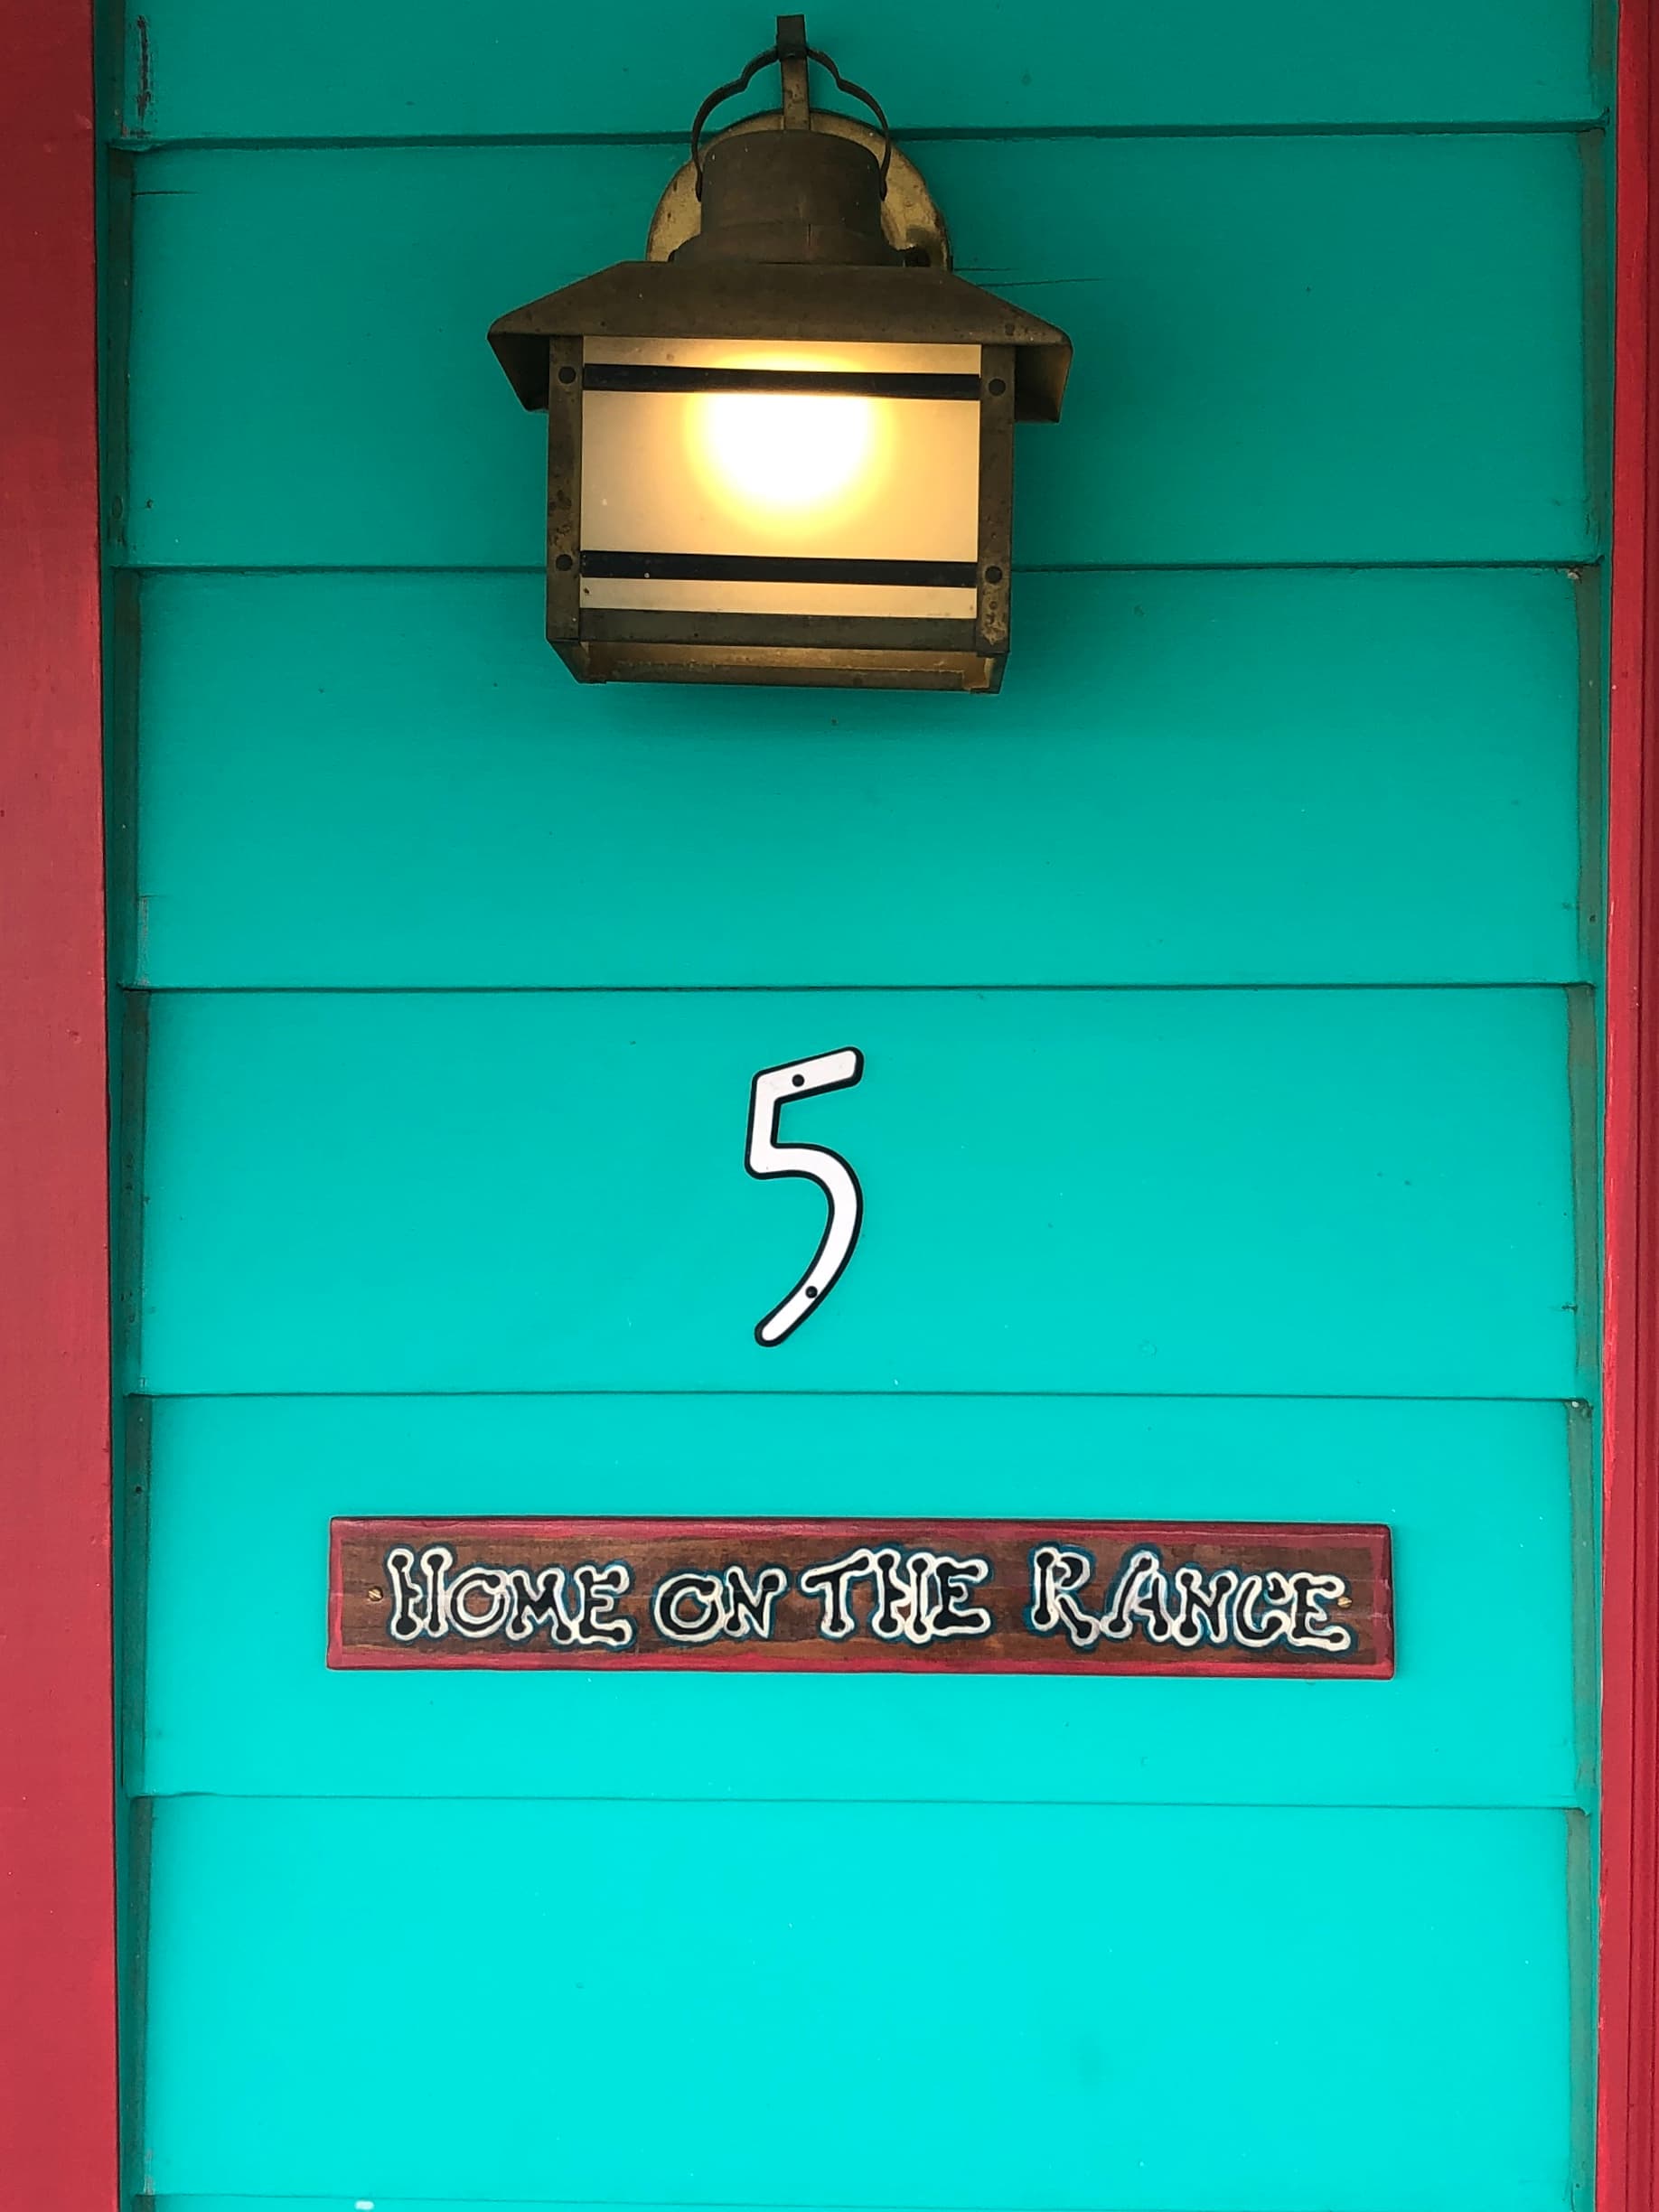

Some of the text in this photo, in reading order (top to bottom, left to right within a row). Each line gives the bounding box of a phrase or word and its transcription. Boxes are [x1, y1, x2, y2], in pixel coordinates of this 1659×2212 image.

[745, 1046, 864, 1347] 5
[386, 1545, 1353, 1652] HOME ON THE RANGE
